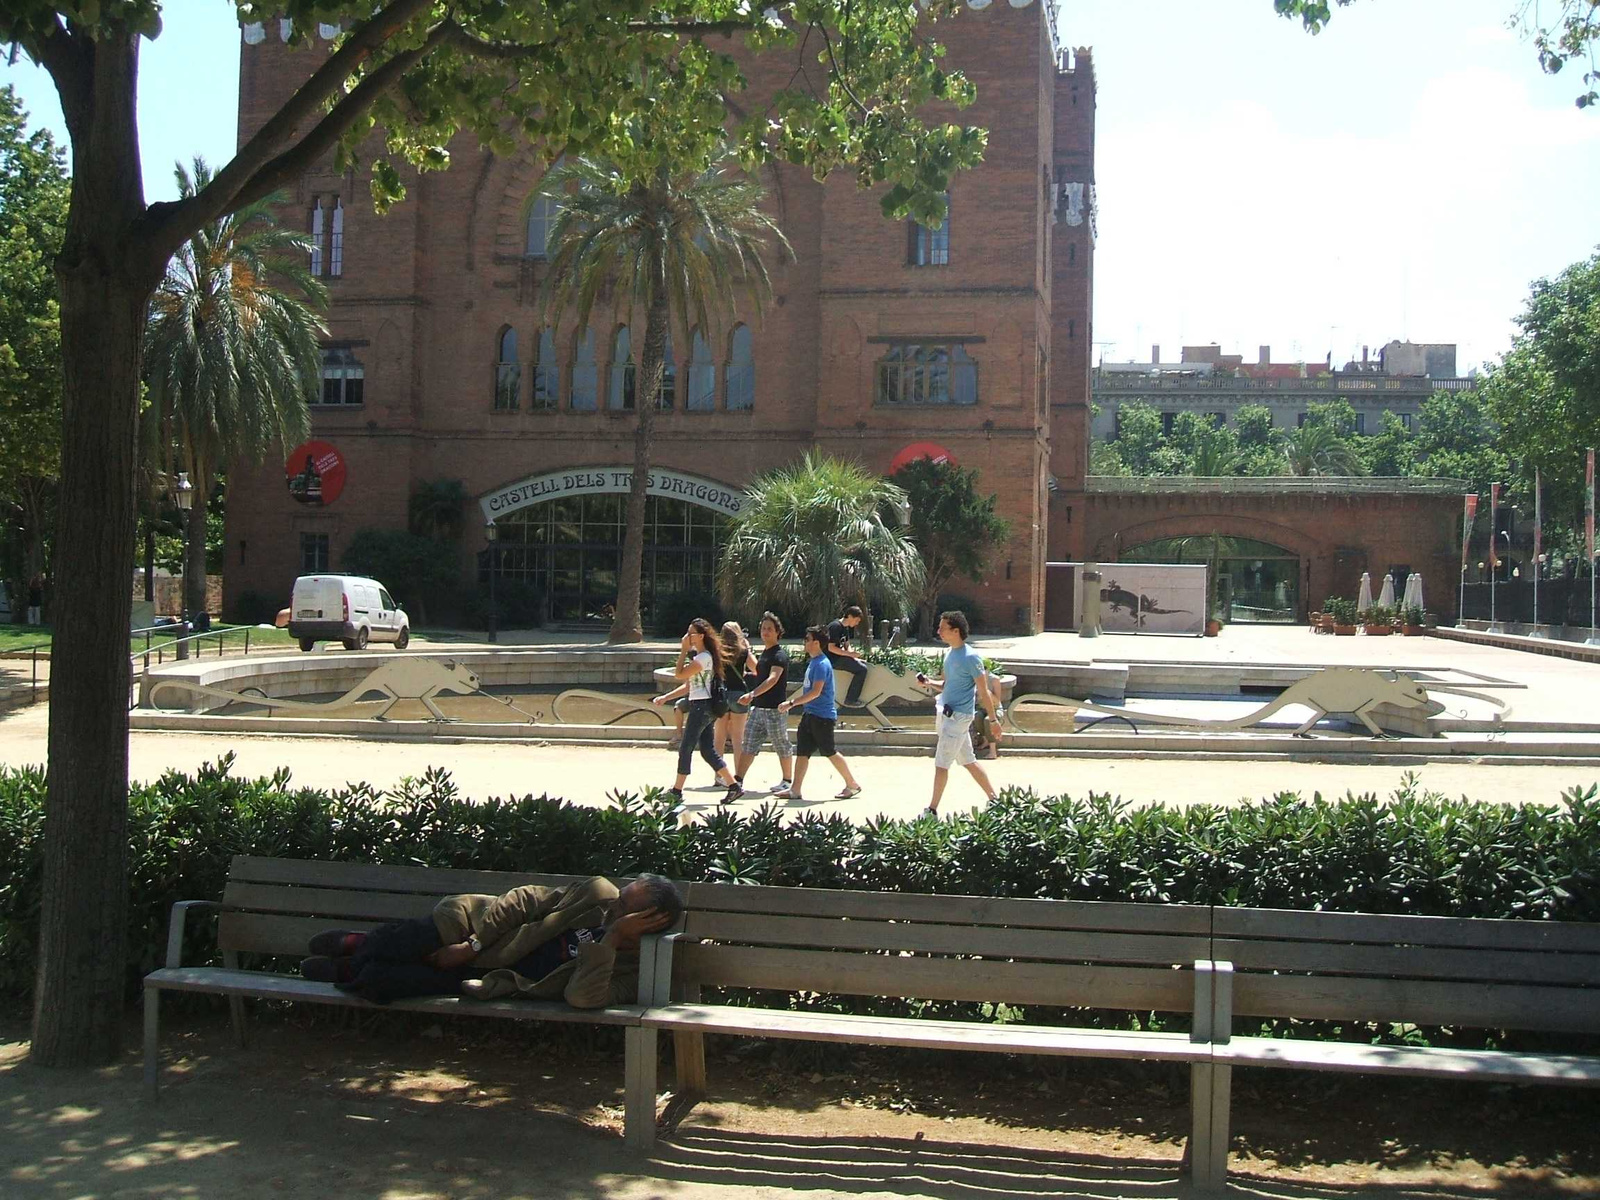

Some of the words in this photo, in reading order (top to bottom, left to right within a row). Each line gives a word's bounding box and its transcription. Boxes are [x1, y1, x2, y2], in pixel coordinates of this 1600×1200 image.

[489, 479, 560, 512] CASTELL
[563, 473, 605, 489] DELS
[611, 472, 655, 488] TRS
[659, 476, 743, 512] DRAGONS
